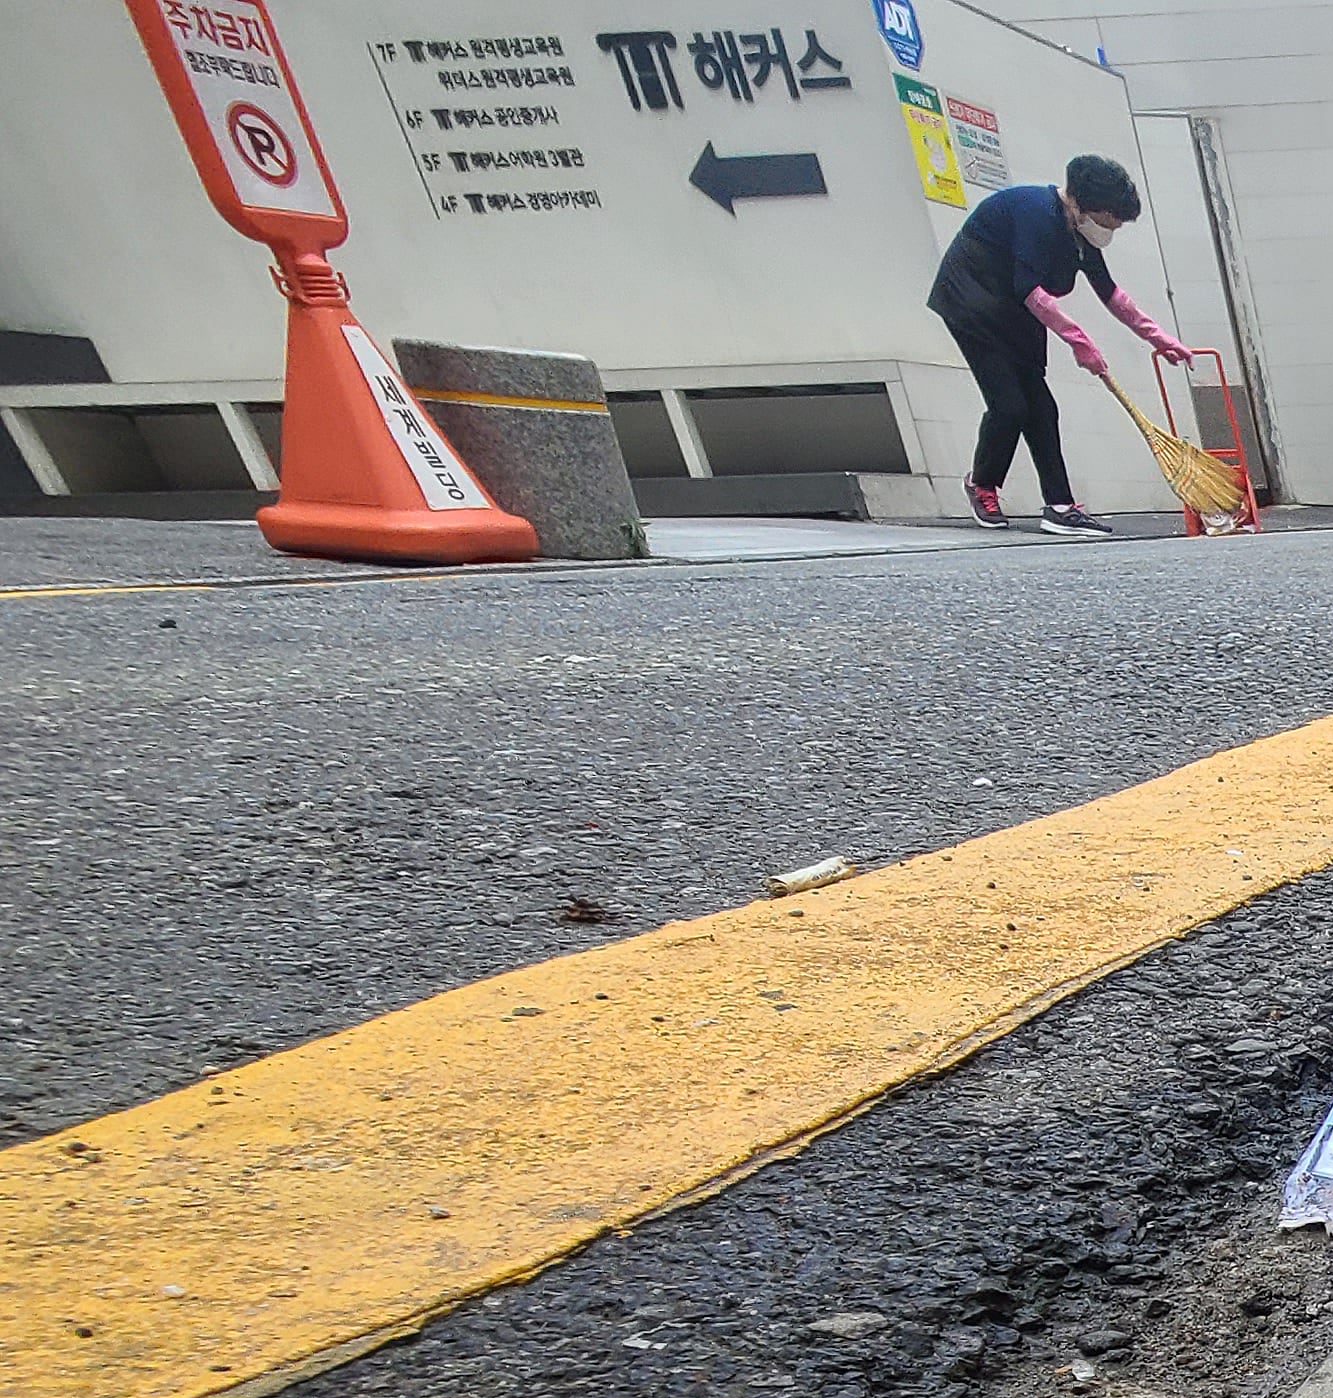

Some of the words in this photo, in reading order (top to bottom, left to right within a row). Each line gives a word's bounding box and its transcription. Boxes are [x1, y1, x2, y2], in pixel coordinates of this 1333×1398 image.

[164, 0, 270, 57] 주차금지
[884, 0, 914, 41] ADT
[376, 43, 397, 62] 7F
[687, 28, 853, 103] 해커스
[421, 153, 441, 172] 5F
[441, 195, 458, 213] 4F
[375, 375, 465, 501] 세계빌딩
